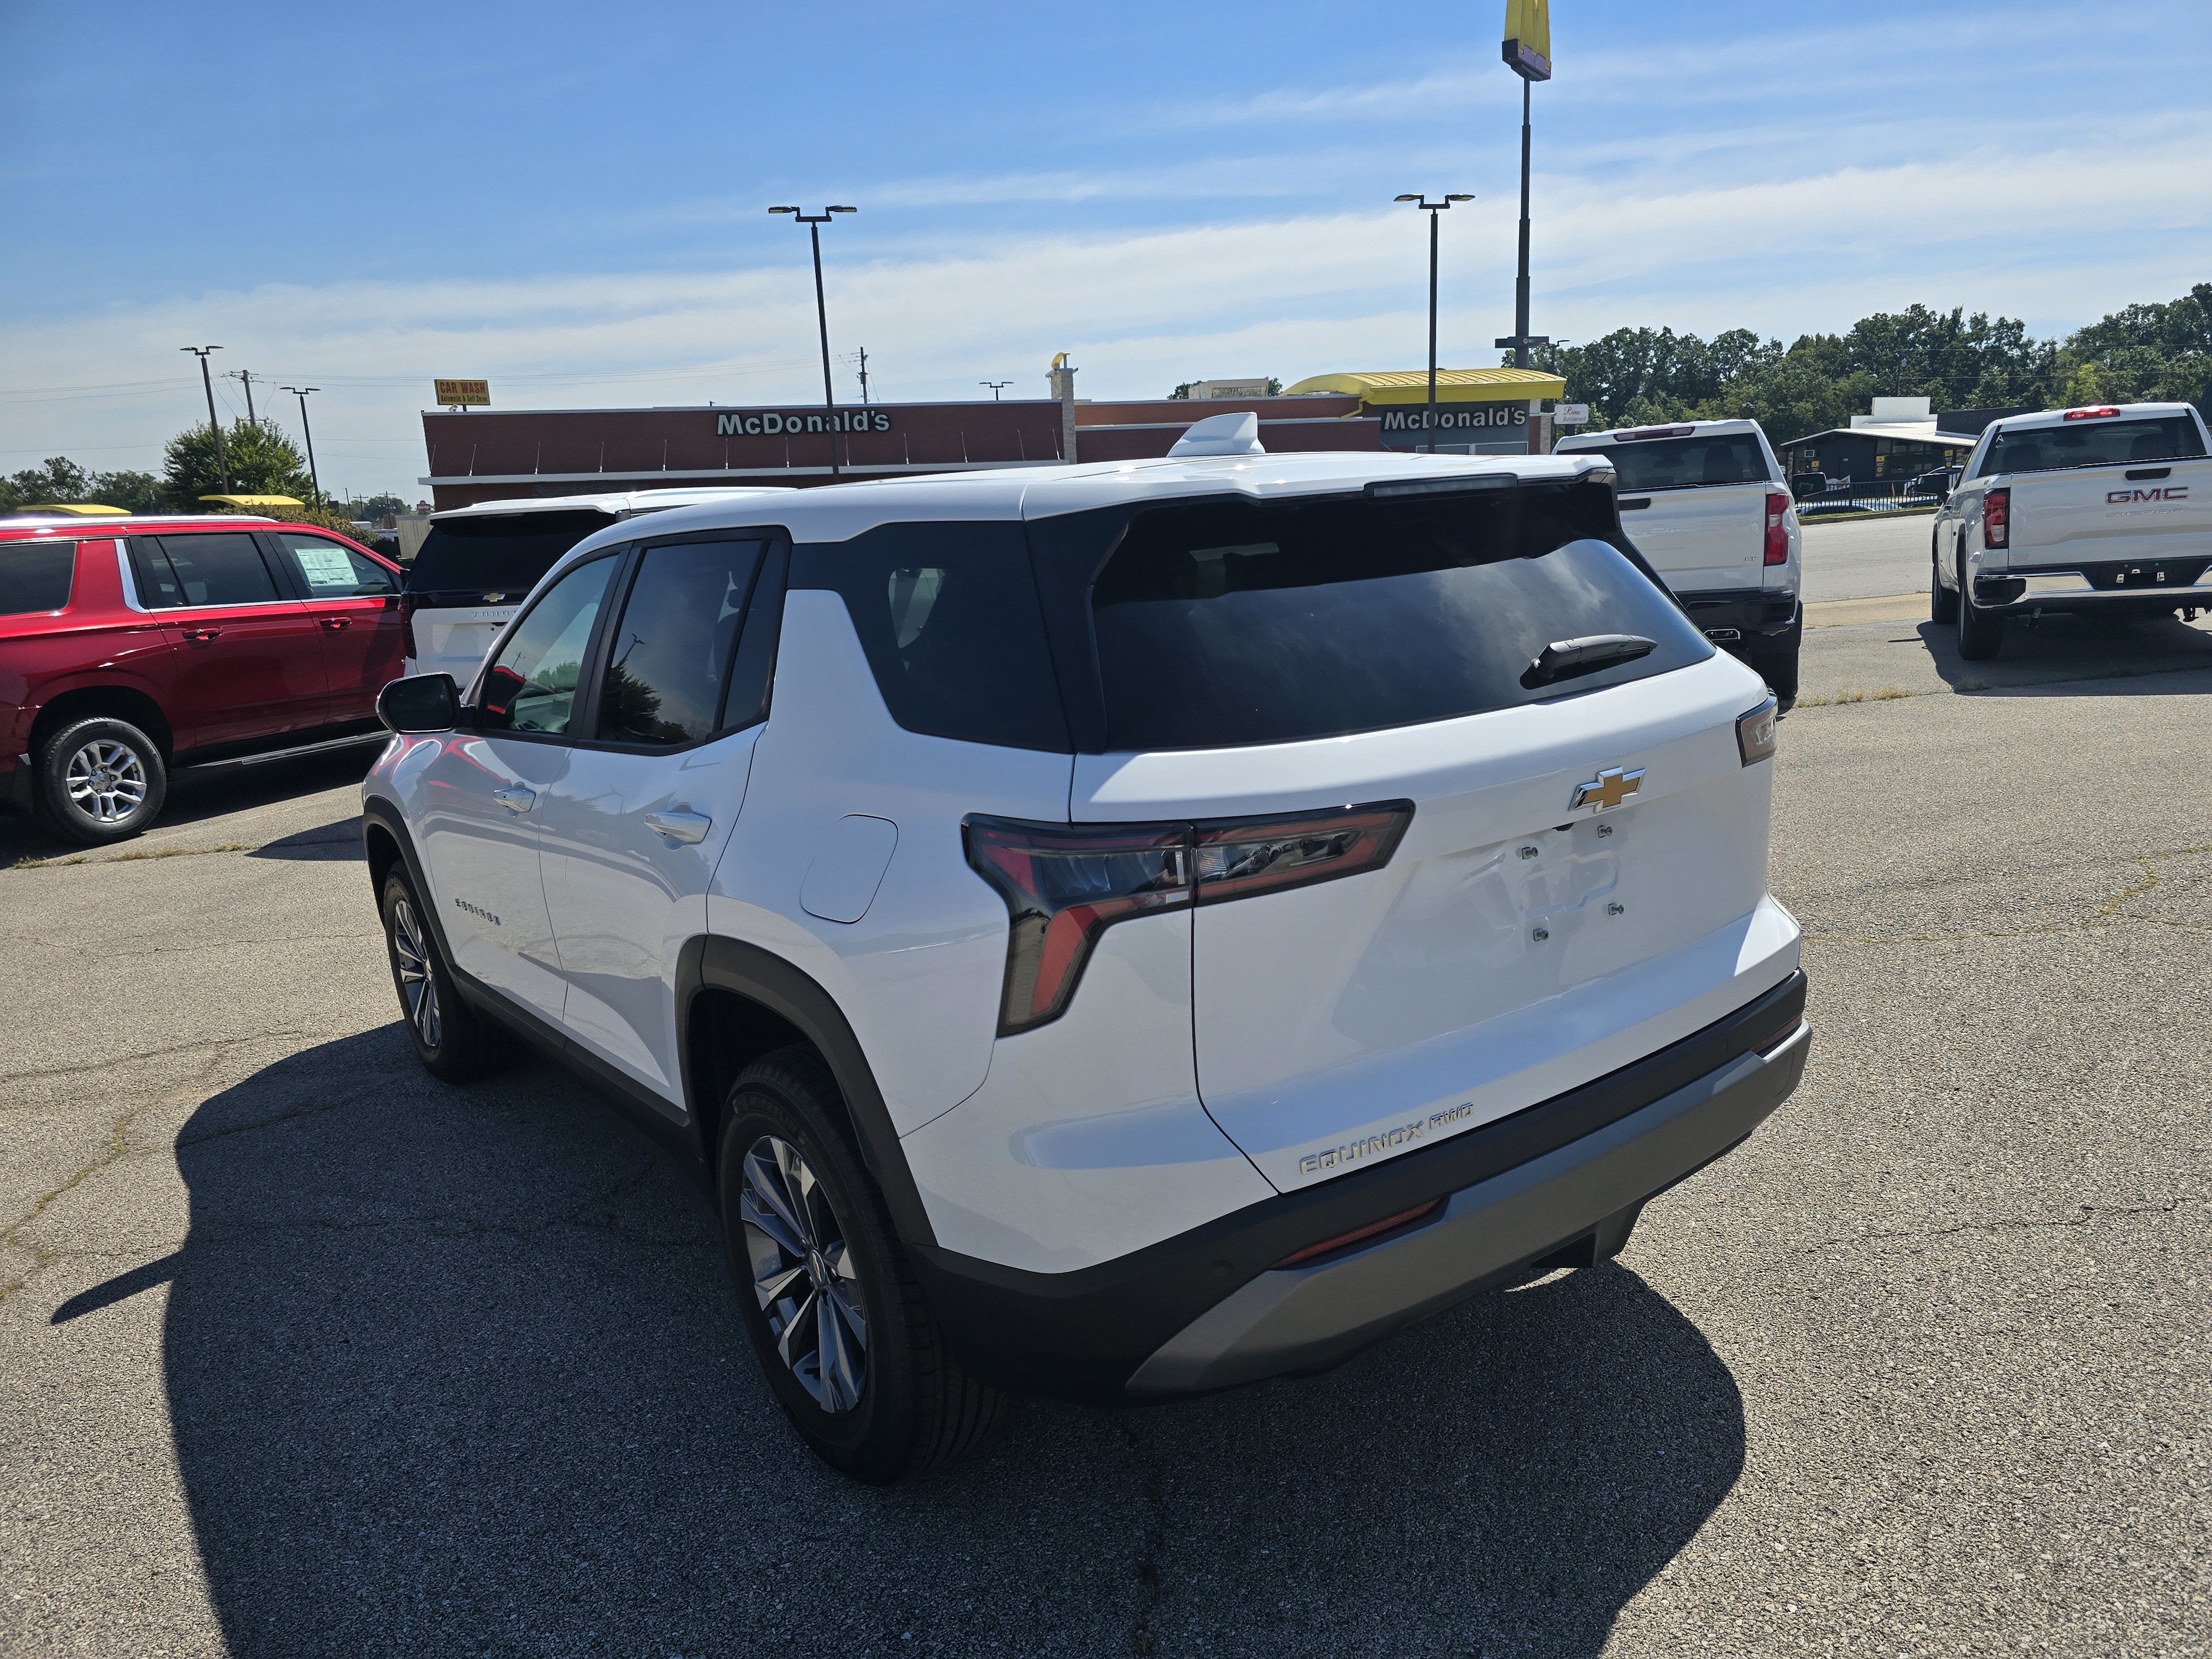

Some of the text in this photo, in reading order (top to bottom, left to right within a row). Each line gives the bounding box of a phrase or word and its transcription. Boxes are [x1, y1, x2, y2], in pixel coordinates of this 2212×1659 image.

[440, 382, 486, 394] CAR WASH
[717, 410, 890, 435] McDonald's
[1384, 407, 1526, 430] McDonald's
[2106, 486, 2189, 504] GMC
[1300, 1102, 1474, 1175] EQUINOX AWD
